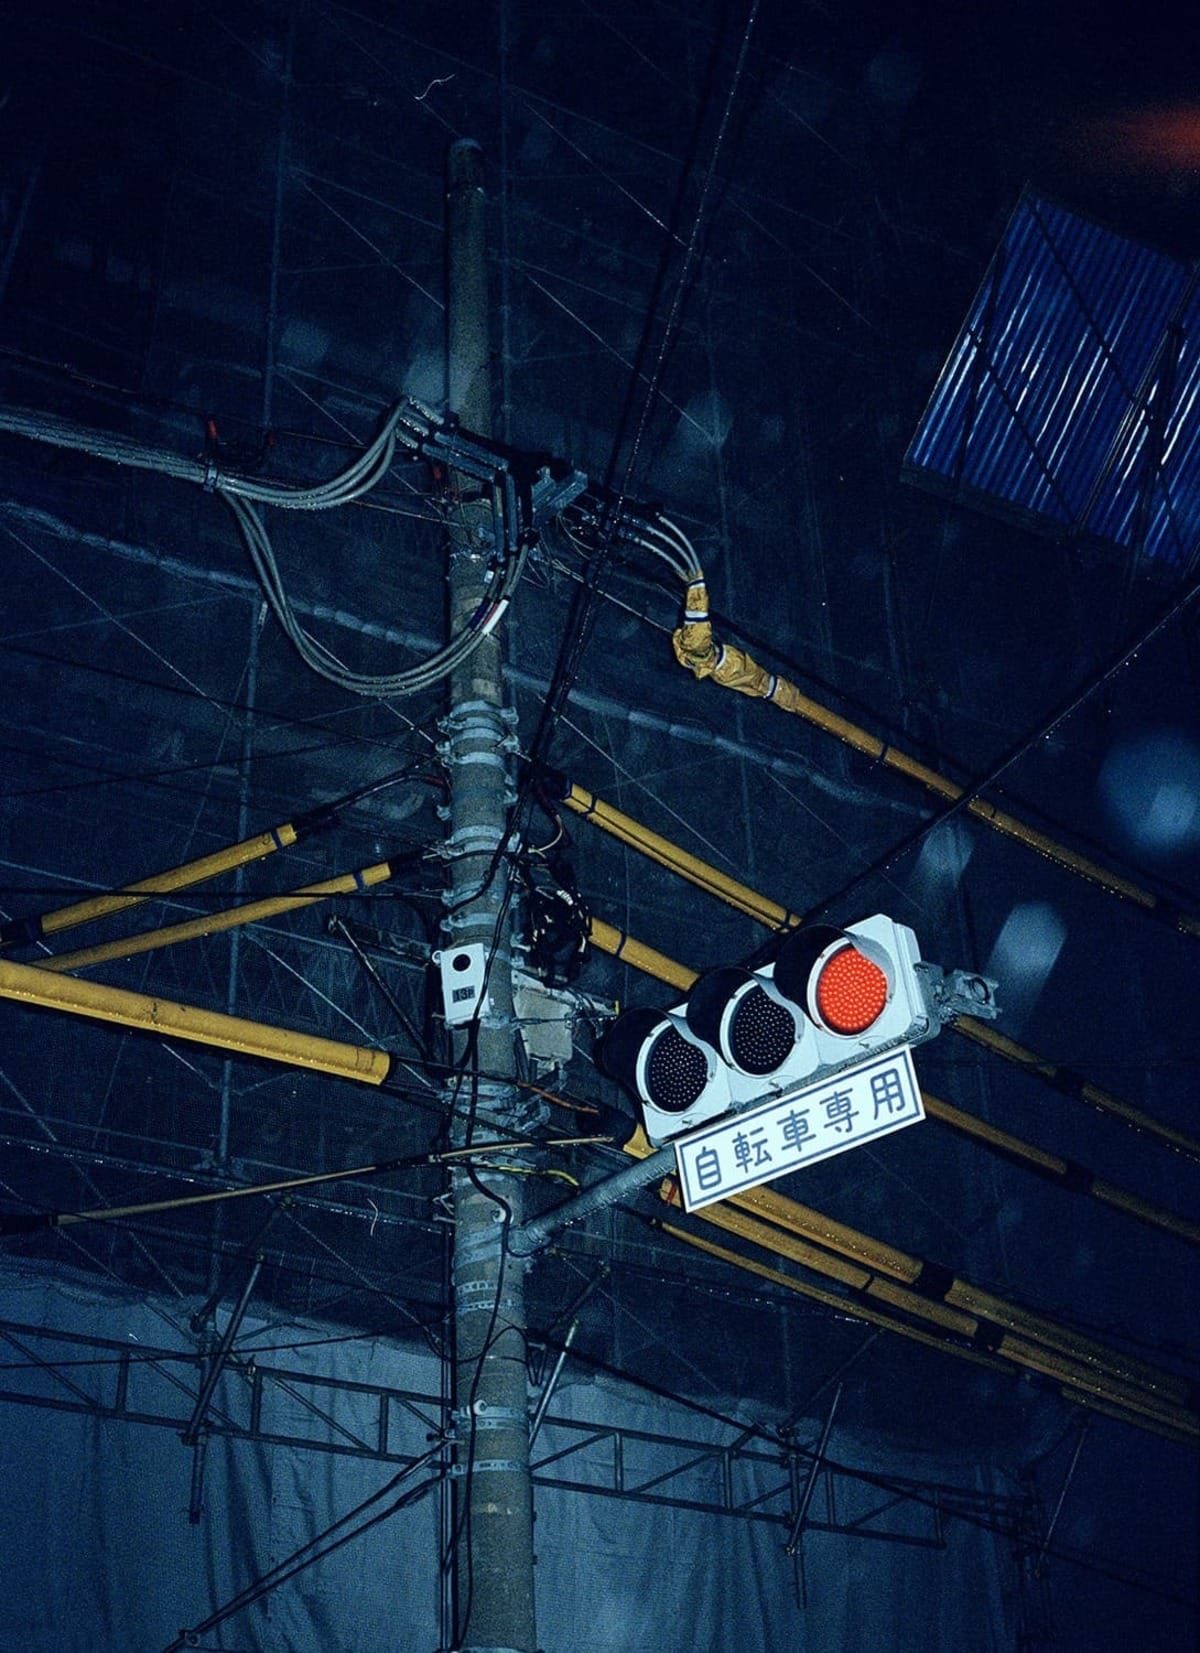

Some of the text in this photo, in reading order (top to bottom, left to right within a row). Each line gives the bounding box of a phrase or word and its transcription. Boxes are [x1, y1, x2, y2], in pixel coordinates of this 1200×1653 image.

[695, 1067, 906, 1190] 自転車専用
